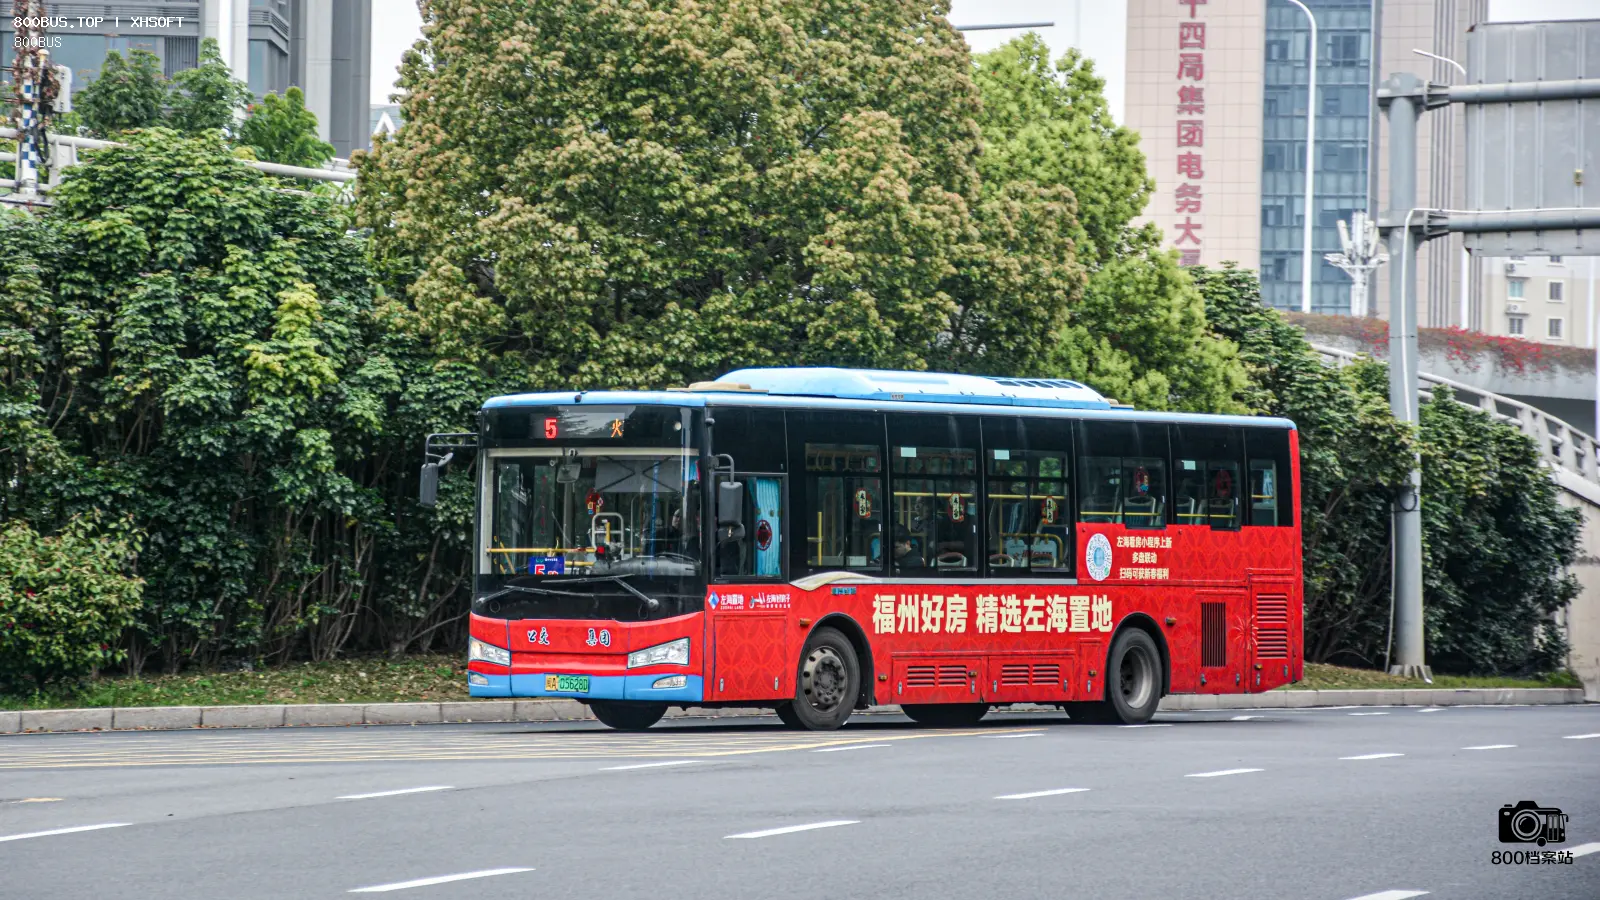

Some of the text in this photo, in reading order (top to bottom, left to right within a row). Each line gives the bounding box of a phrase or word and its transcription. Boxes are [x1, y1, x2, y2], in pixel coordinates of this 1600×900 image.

[544, 418, 558, 439] 5
[534, 564, 559, 575] 5
[872, 594, 1114, 634] 福州好房 精选左海置地
